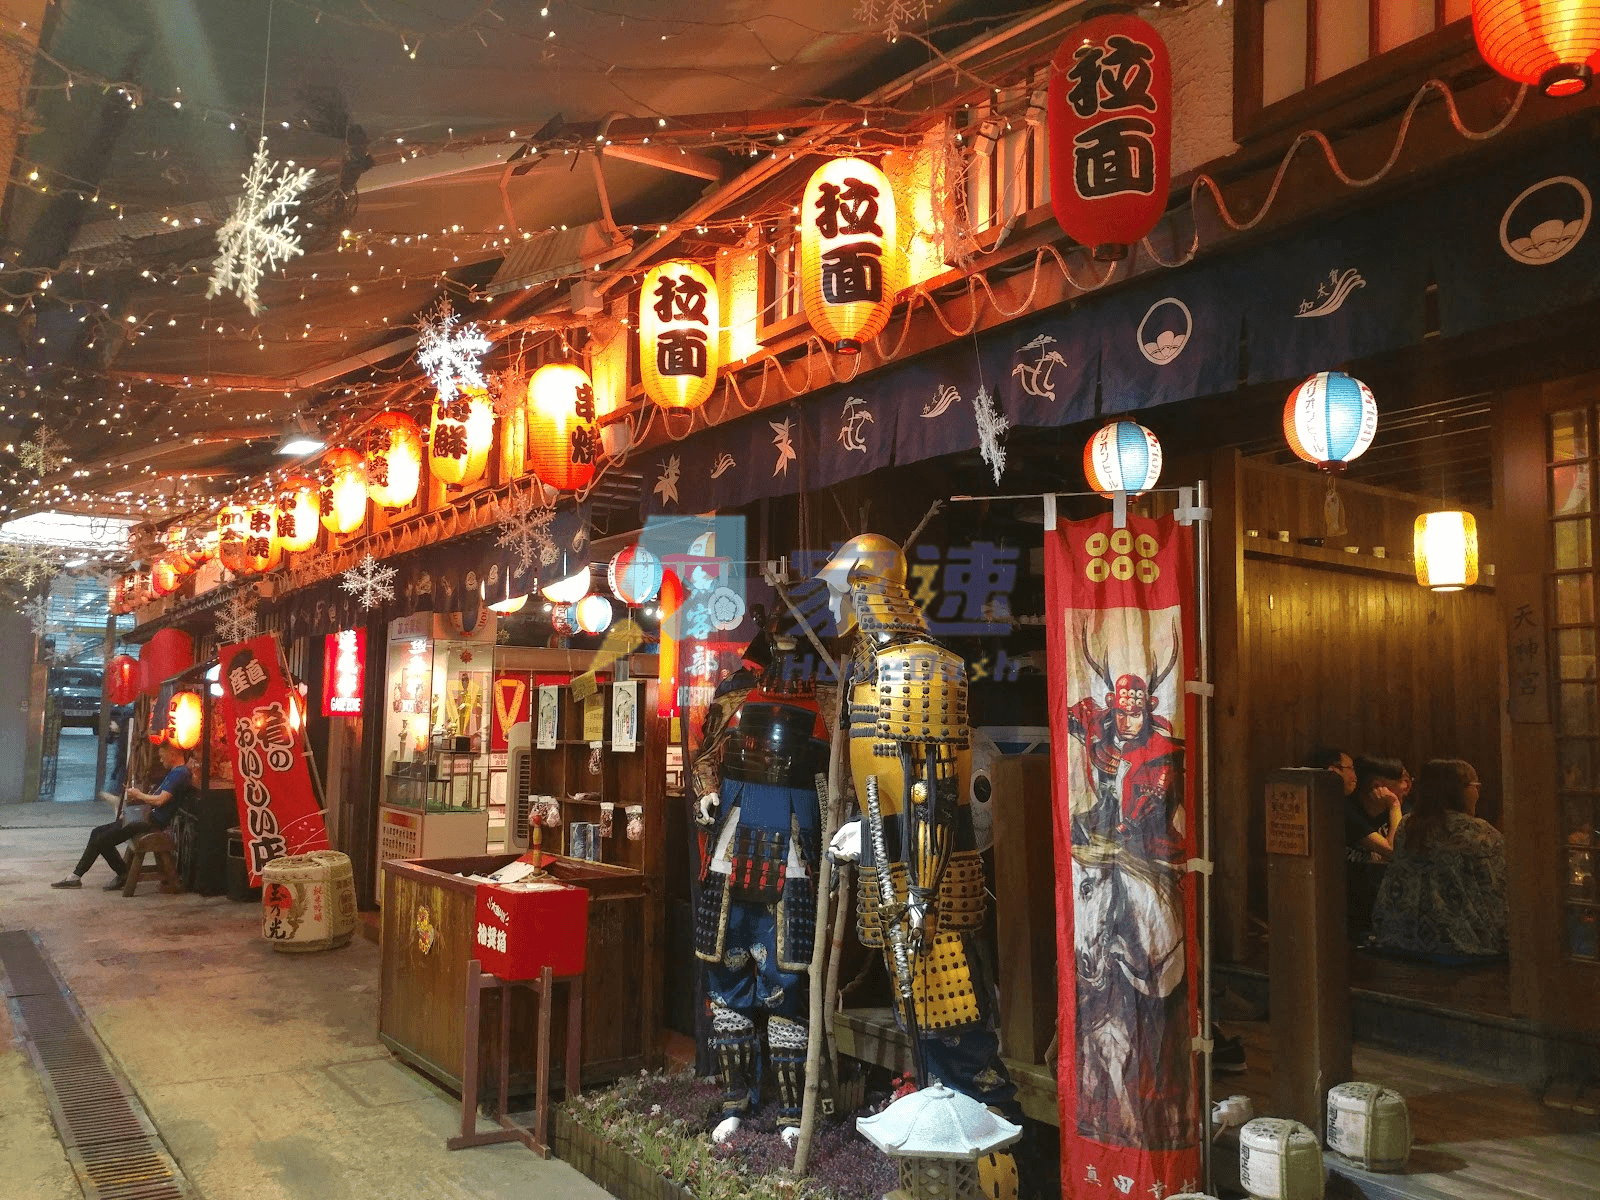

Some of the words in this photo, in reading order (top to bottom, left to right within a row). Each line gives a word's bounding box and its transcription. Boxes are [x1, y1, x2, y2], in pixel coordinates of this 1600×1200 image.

[1065, 34, 1158, 201] 拉面
[814, 177, 884, 305] 拉面
[652, 274, 710, 378] 拉面
[571, 383, 598, 466] 串燒
[247, 511, 271, 559] 串燒
